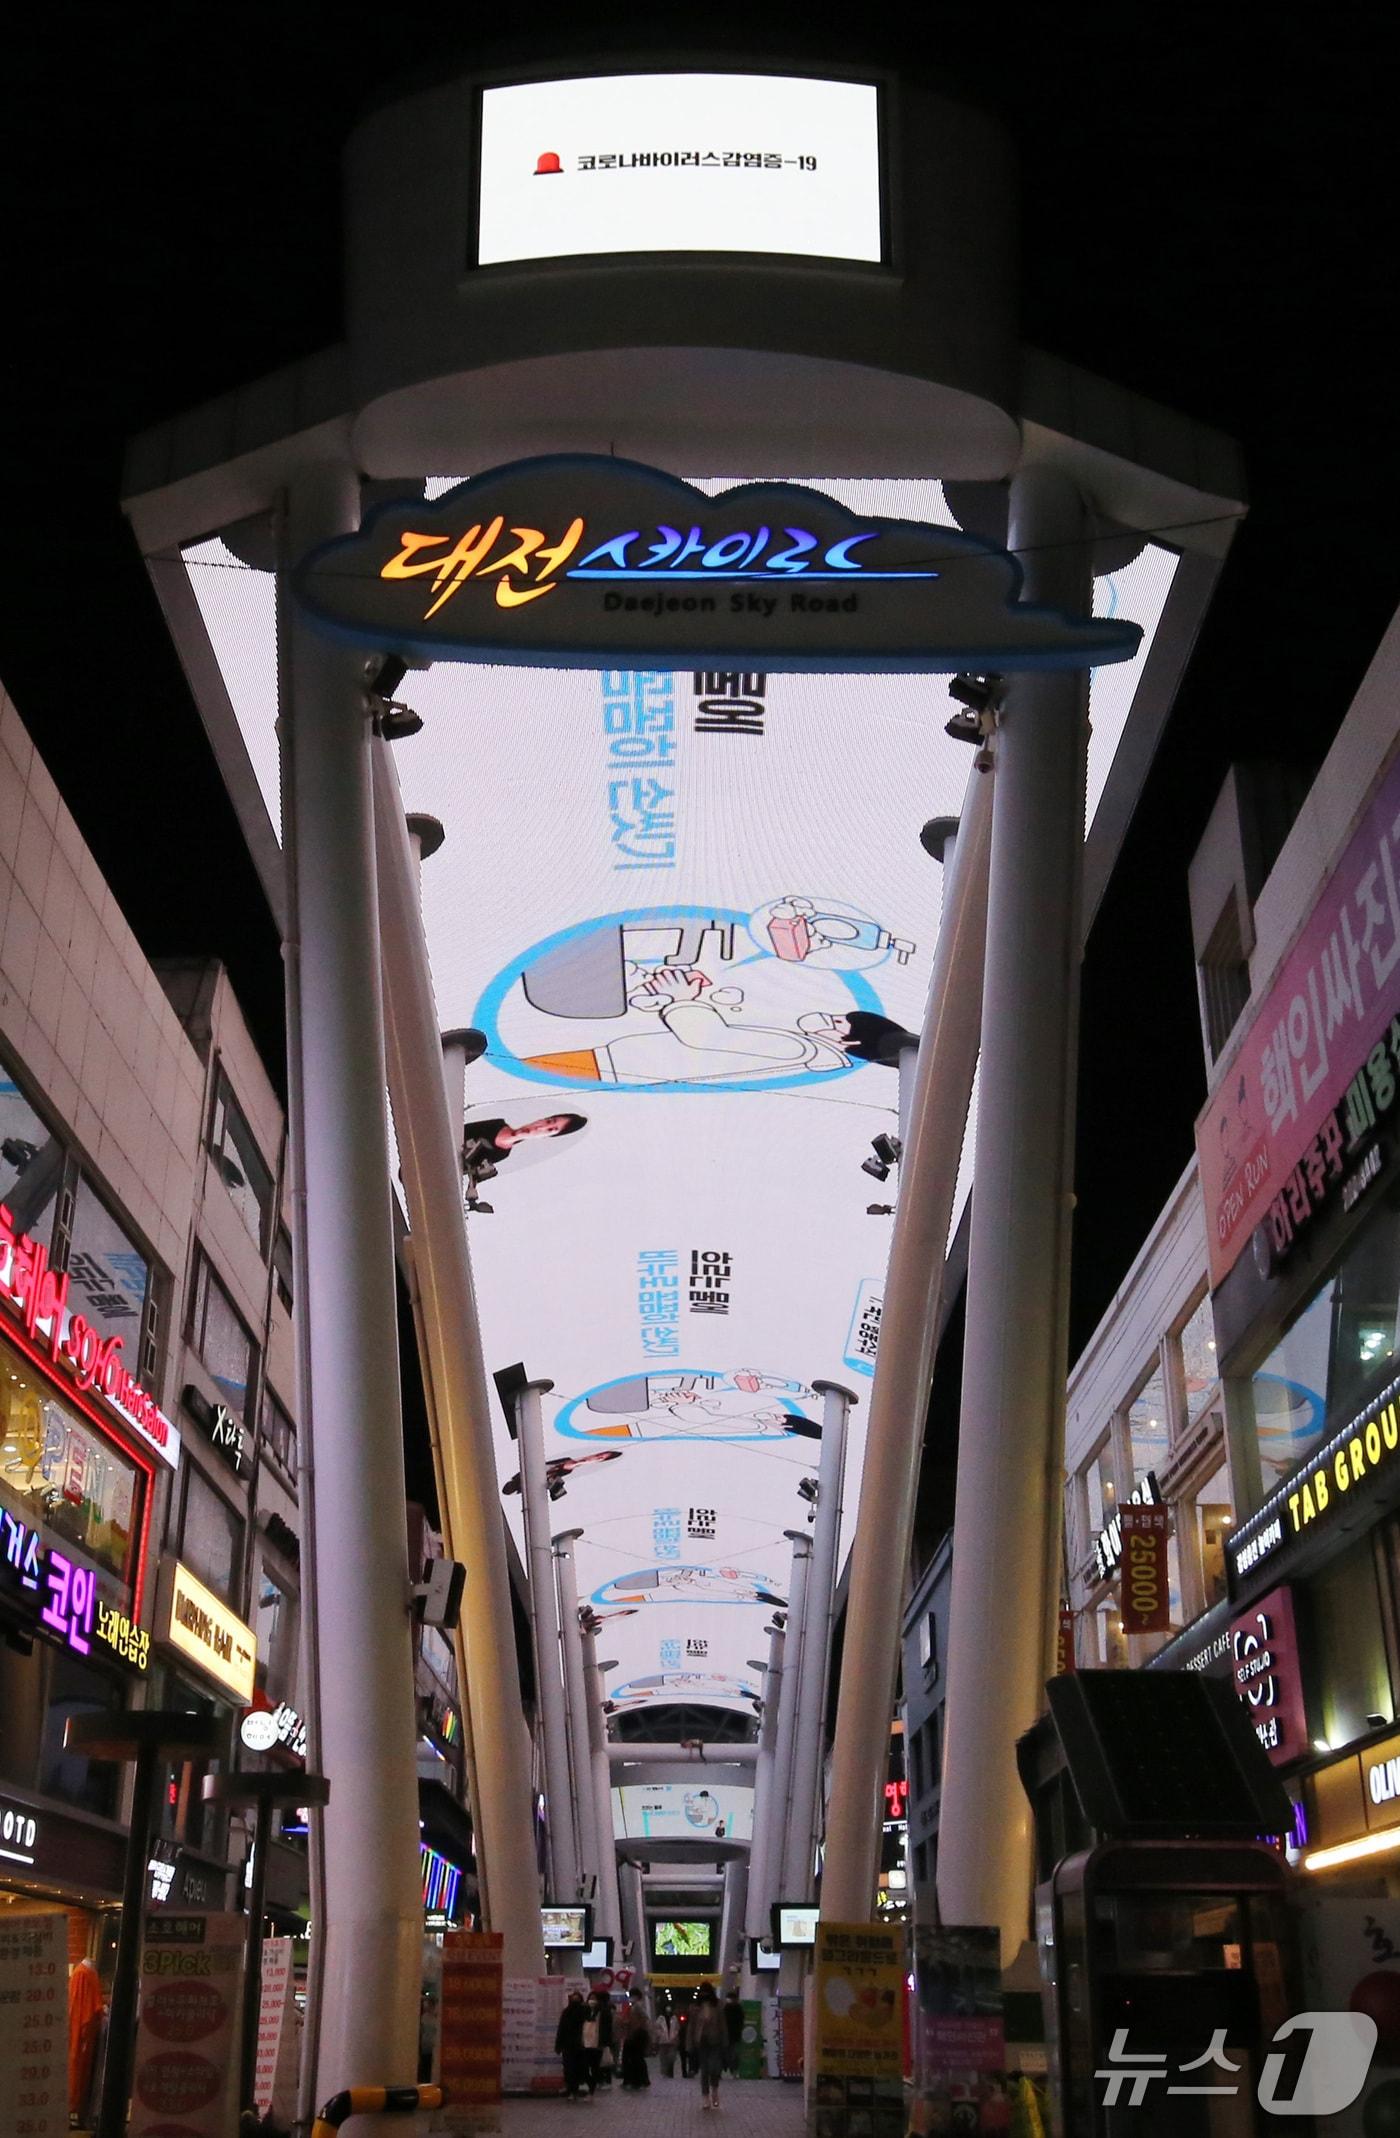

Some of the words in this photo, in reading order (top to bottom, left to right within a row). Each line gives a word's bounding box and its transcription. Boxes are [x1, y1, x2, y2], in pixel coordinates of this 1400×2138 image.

[577, 151, 818, 171] 코로나바이러스감염증-19
[380, 516, 584, 620] 대전
[604, 592, 716, 617] Daejeon
[730, 592, 778, 617] Sky
[789, 592, 858, 615] Road
[607, 777, 676, 871] 손씻기
[1260, 813, 1400, 1137] 핵인싸진
[1217, 1183, 1244, 1241] OPEN
[1243, 1144, 1269, 1197] RUN
[1288, 1470, 1329, 1533] TAB
[1334, 1396, 1400, 1492] GROU
[42, 1550, 96, 1656] 코인
[96, 1600, 150, 1670] 노래연습장
[1213, 1631, 1231, 1659] CAFE
